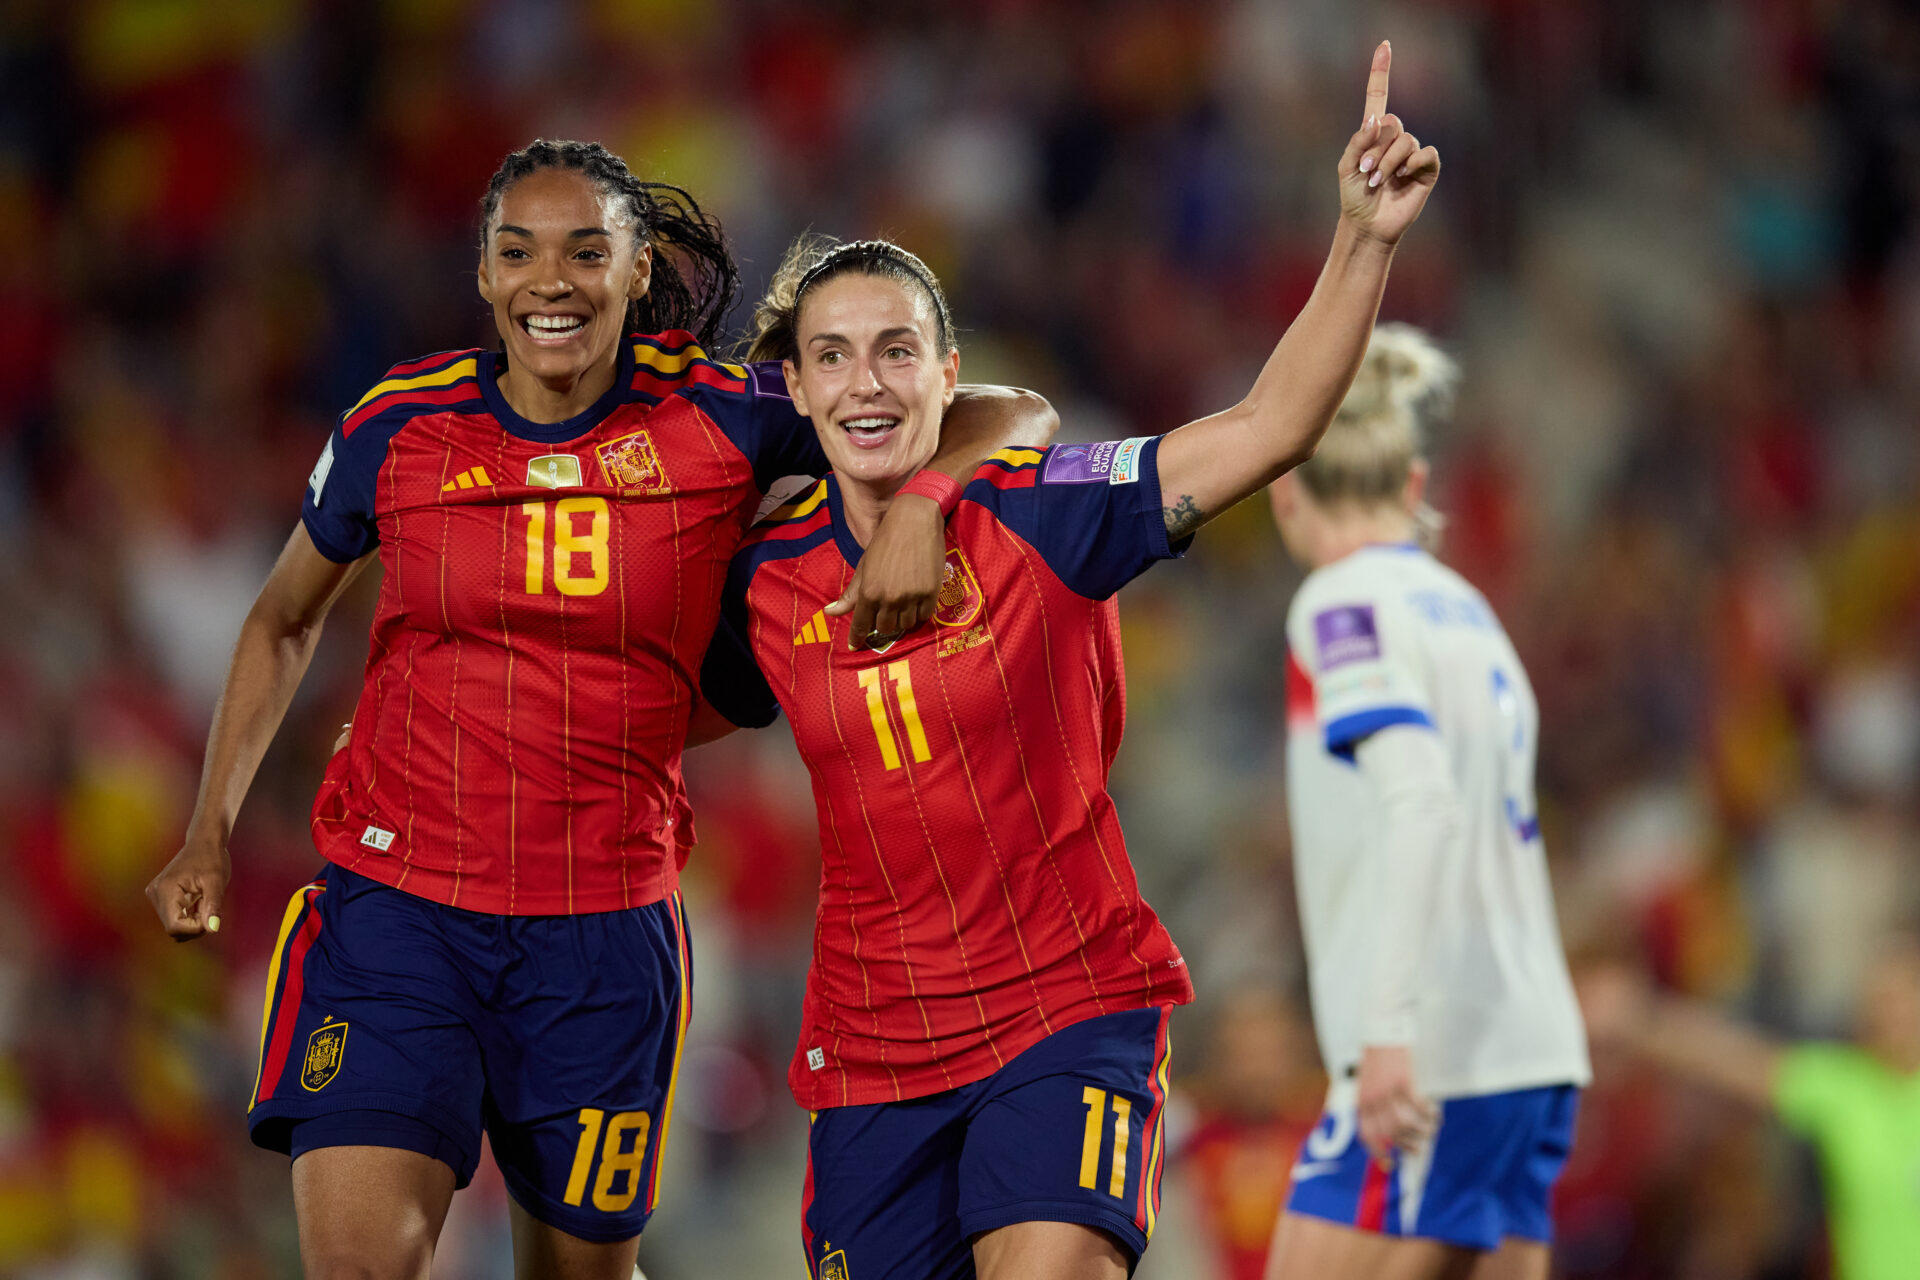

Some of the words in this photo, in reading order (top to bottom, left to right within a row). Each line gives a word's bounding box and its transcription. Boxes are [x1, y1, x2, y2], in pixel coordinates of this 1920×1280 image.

[624, 489, 641, 497] SPAIN
[646, 487, 672, 496] ENGLAND
[1111, 462, 1120, 482] UEFA
[523, 496, 610, 596] 18
[938, 647, 957, 658] PALMA
[965, 634, 992, 650] MALLORCA
[859, 660, 932, 770] 11
[563, 1108, 651, 1212] 18
[1079, 1086, 1132, 1199] 11
